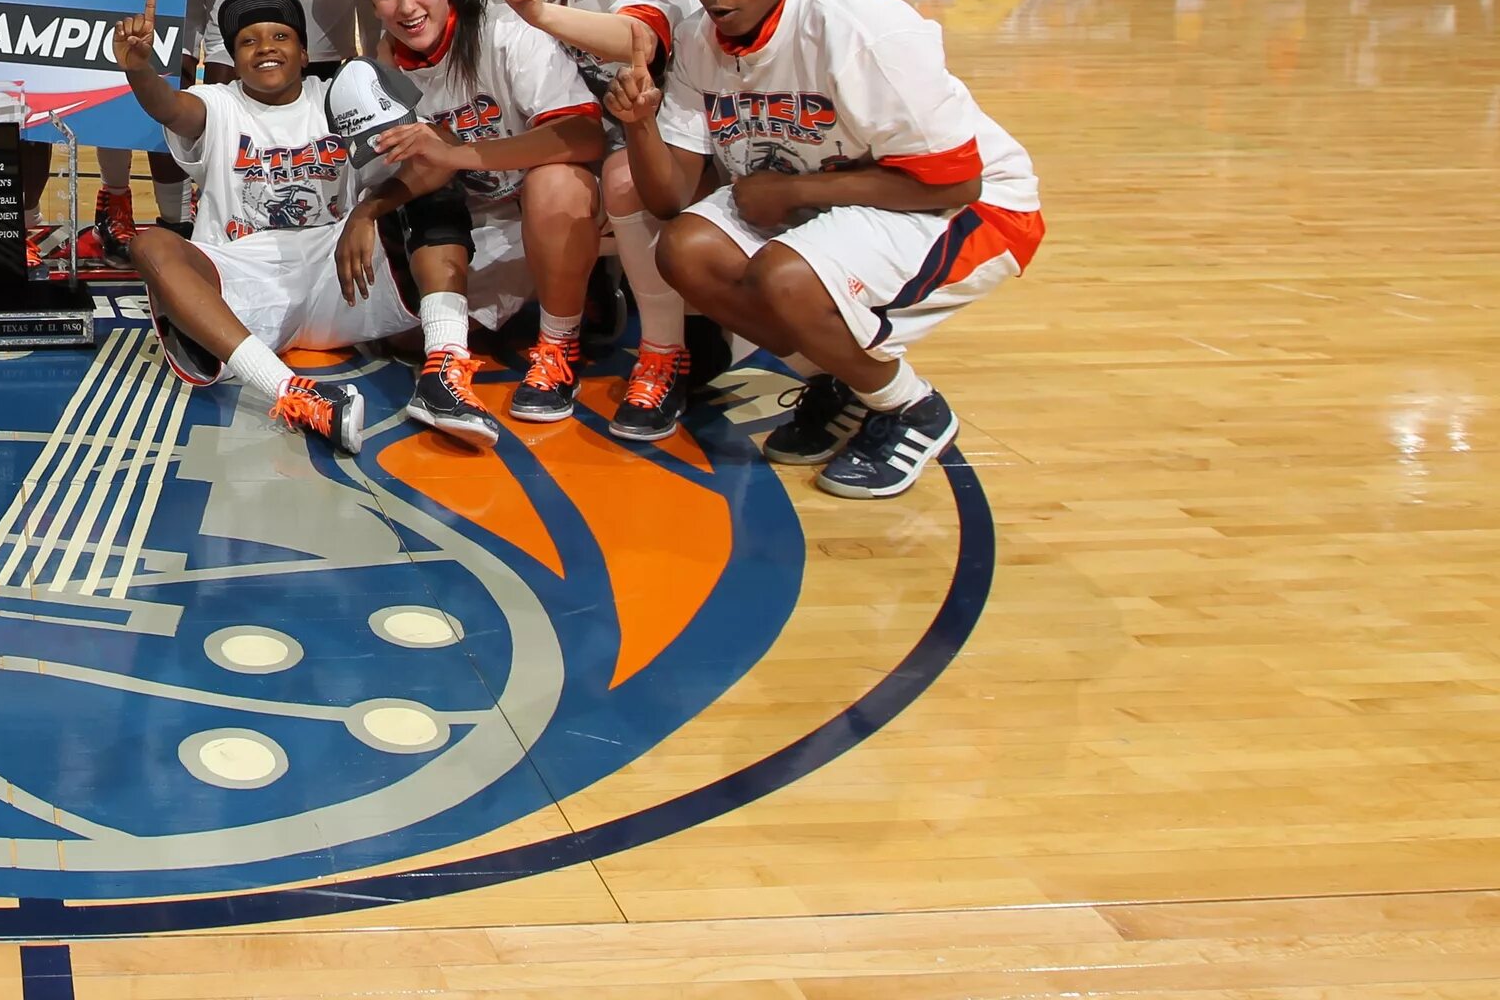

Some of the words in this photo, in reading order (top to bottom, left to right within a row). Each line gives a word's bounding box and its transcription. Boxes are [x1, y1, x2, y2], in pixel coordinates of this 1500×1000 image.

[428, 91, 503, 130] TEP
[702, 88, 838, 131] UTEP
[233, 132, 349, 171] UTEP
[2, 324, 29, 332] TEXAS
[32, 324, 44, 332] AT
[48, 324, 58, 332] EL
[63, 323, 82, 332] PASO
